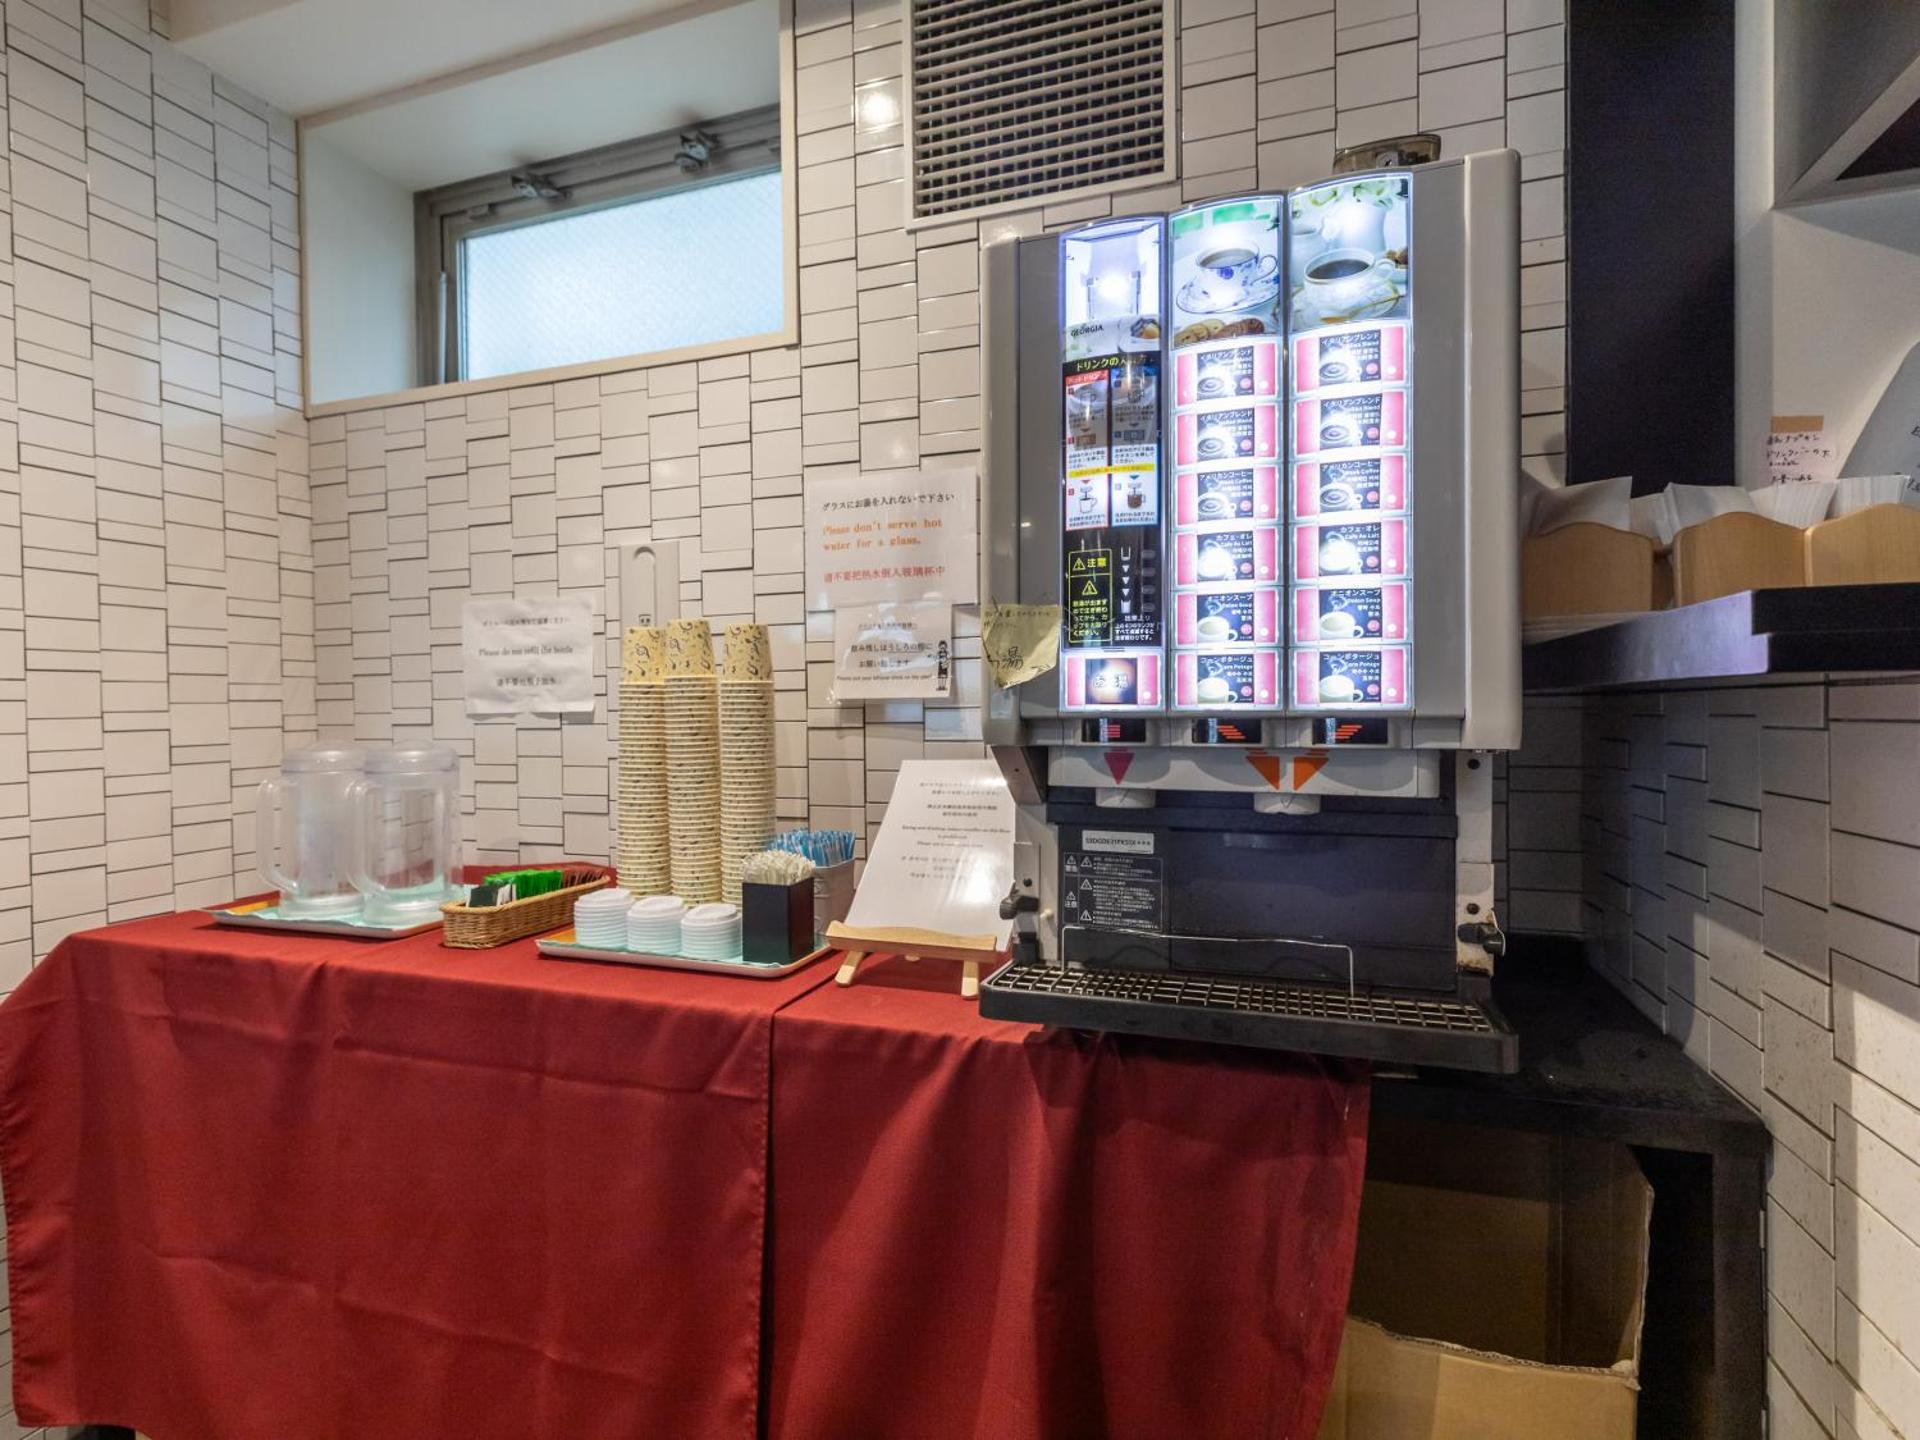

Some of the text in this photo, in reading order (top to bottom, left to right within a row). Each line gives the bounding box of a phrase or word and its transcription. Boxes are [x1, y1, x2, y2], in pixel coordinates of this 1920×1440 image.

[1070, 324, 1104, 337] GEORGIA
[822, 492, 955, 511] グラスにお湯を入れないで下さい
[853, 521, 881, 533] don't
[887, 520, 918, 530] serve
[924, 517, 943, 529] hot
[823, 541, 851, 551] water
[856, 538, 872, 549] for
